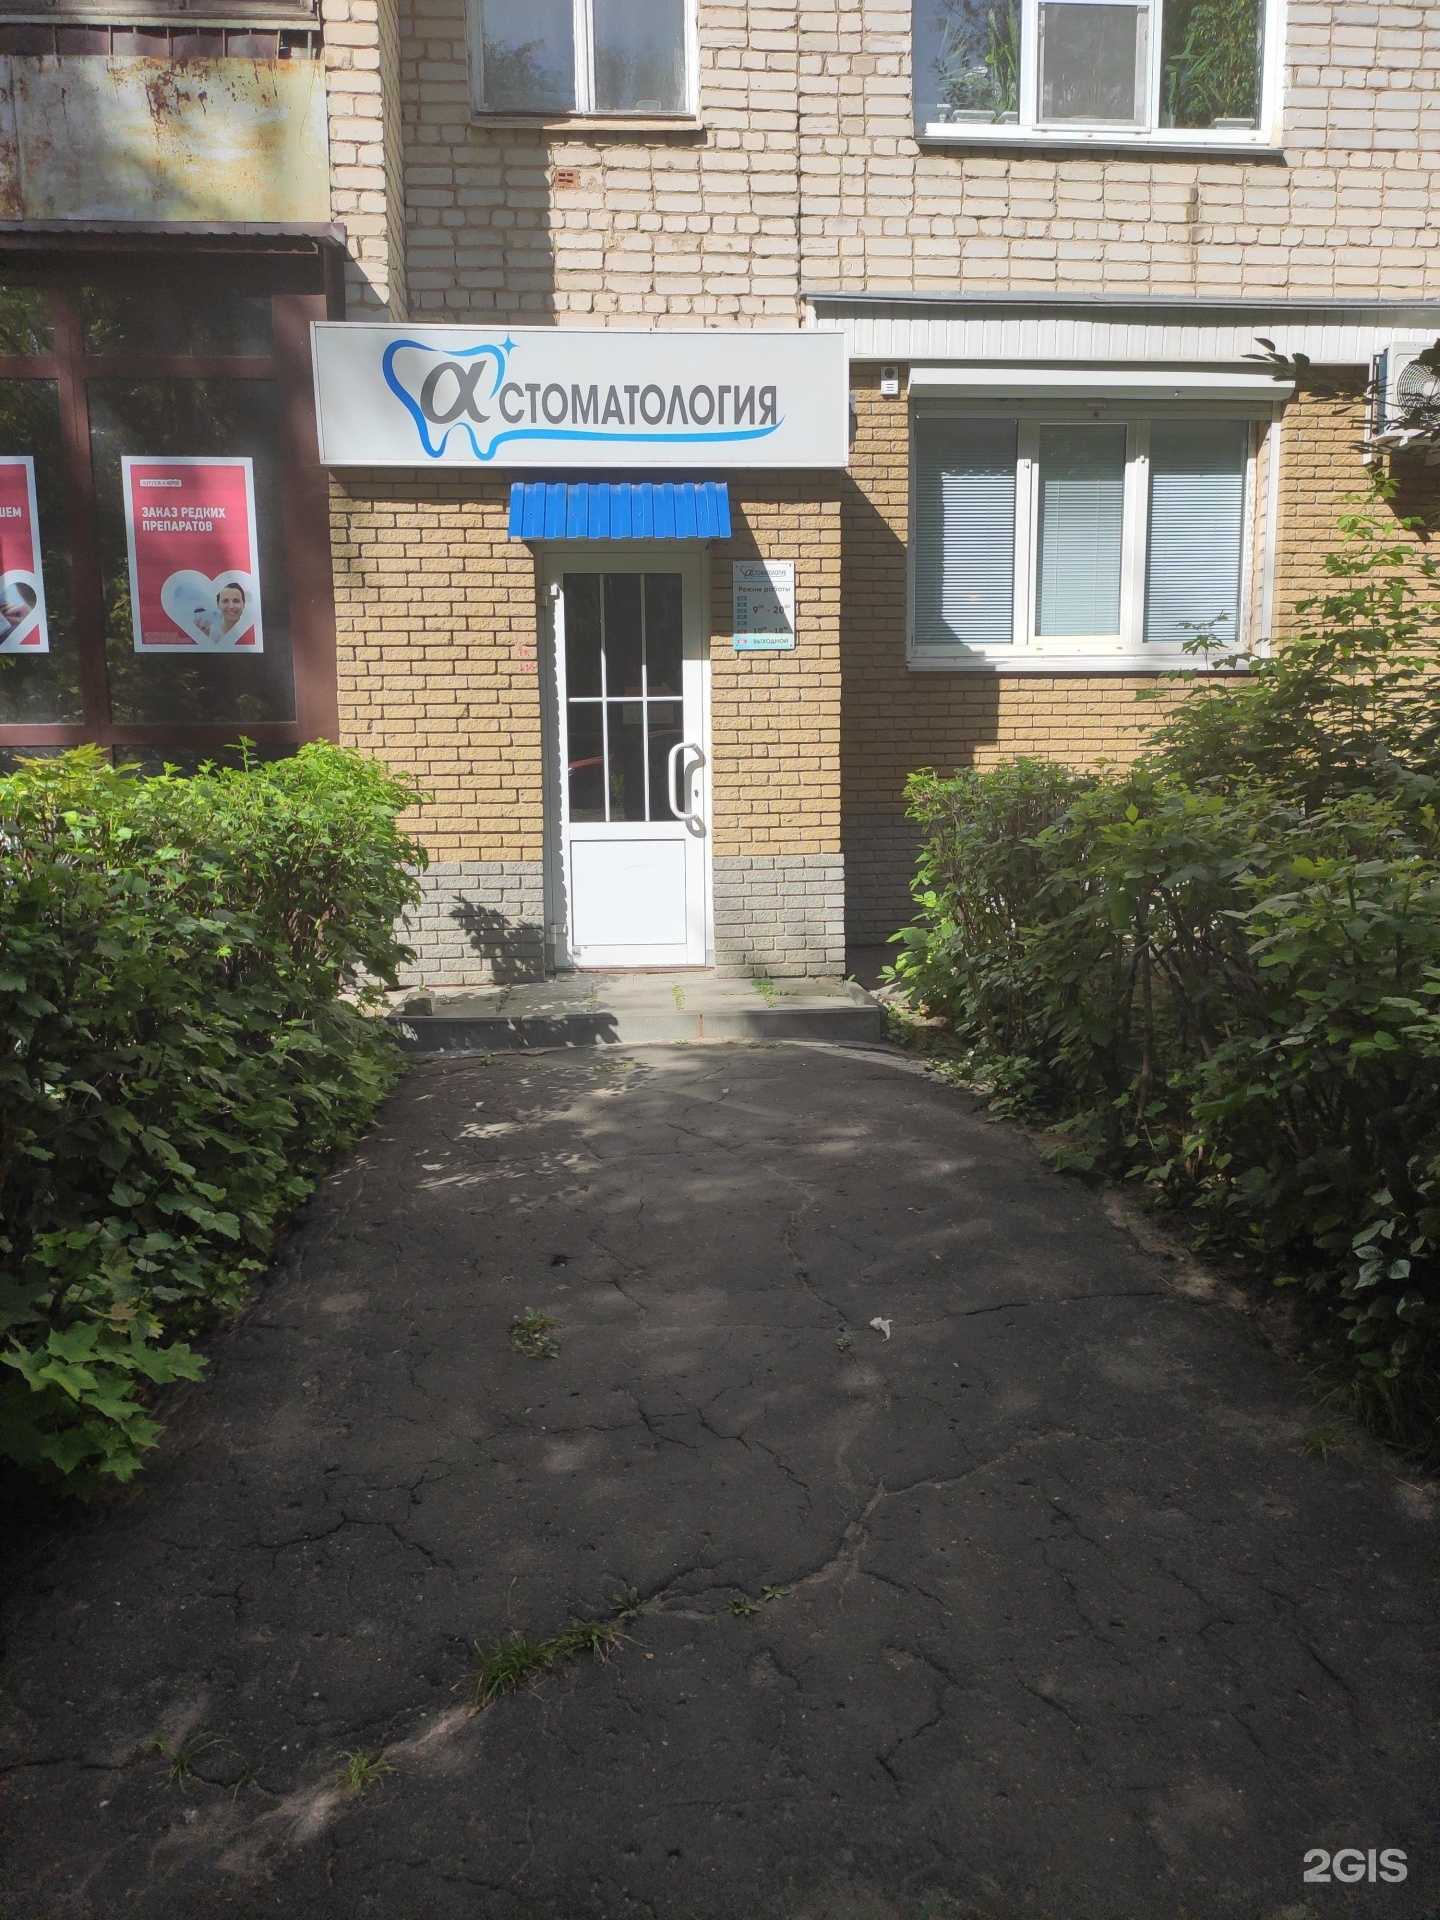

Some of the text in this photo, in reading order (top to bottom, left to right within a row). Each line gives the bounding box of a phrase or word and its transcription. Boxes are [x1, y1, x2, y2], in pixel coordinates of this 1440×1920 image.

[499, 382, 778, 426] СТОМАТОЛОГИЯ
[142, 506, 226, 520] ЗАКАЗ РЕДКИХ
[142, 520, 213, 532] ПРЕПАРАТОВ
